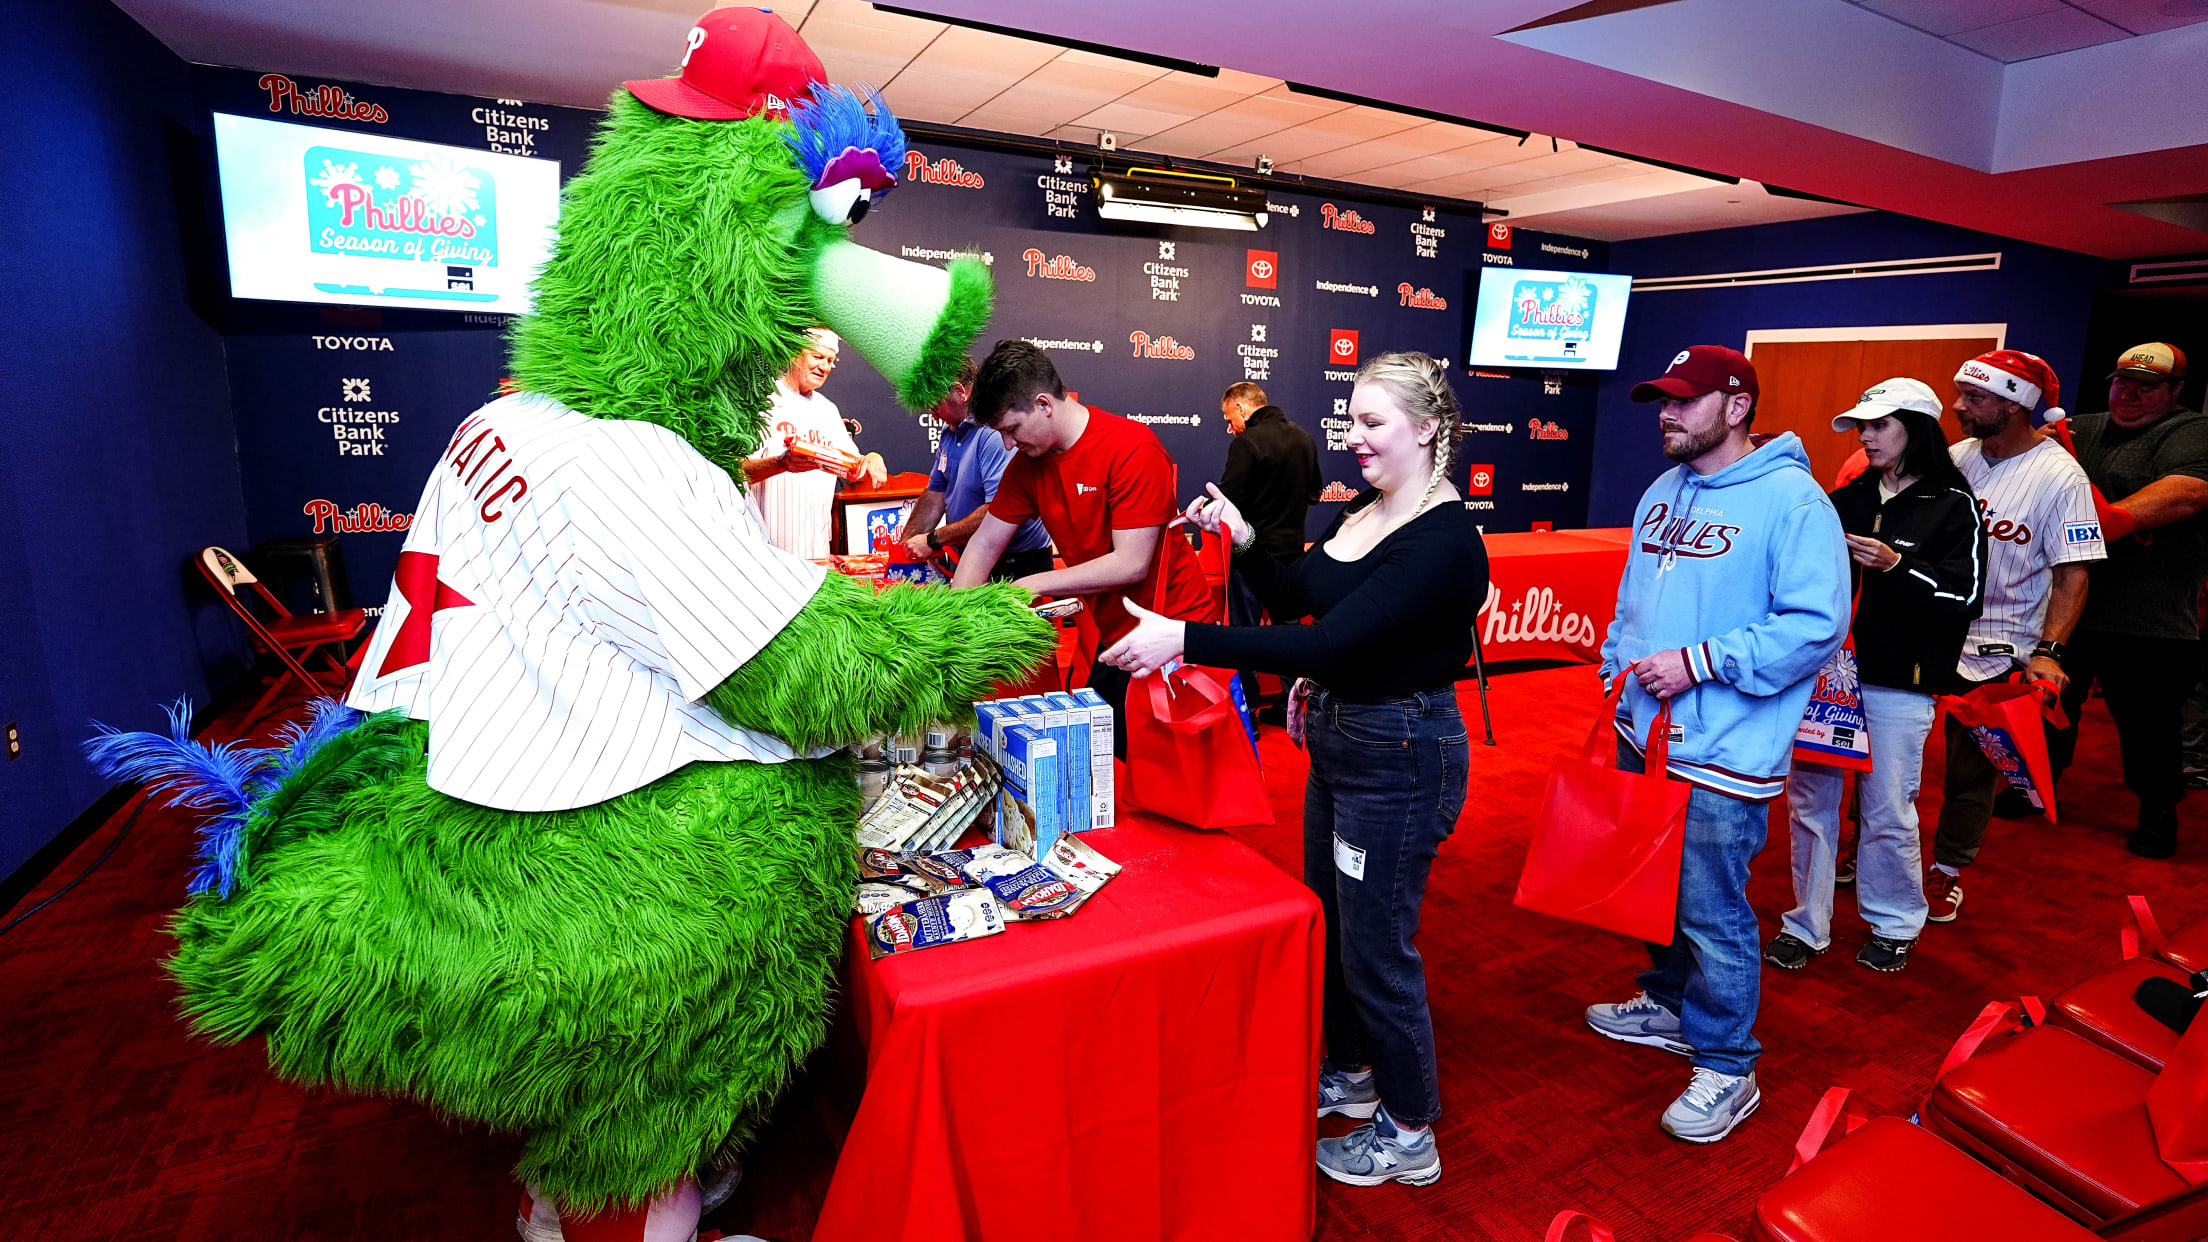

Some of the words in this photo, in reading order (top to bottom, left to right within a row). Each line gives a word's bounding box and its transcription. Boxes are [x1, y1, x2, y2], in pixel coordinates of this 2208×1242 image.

[258, 74, 389, 124] Phillies
[472, 107, 549, 132] Citizens
[486, 126, 534, 147] Bank
[905, 151, 984, 188] Phillies
[1037, 175, 1088, 193] Citizens
[1045, 190, 1077, 206] Bank
[329, 183, 477, 239] Phillies
[1047, 204, 1075, 218] Park
[1320, 203, 1375, 235] Phillies
[1410, 223, 1445, 238] Citizens
[319, 229, 399, 255] Season
[403, 240, 423, 262] of
[430, 238, 494, 266] Giving
[1415, 235, 1437, 248] Bank
[1541, 243, 1582, 256] Independence
[1416, 246, 1436, 258] Park
[1482, 253, 1513, 265] TOYOTA
[1023, 248, 1095, 282] Phillies
[1143, 262, 1189, 278] Citizens
[1150, 276, 1180, 290] Bank
[1316, 280, 1369, 295] Independence
[1152, 288, 1178, 301] Park
[1240, 293, 1281, 308] TOYOTA
[1398, 282, 1447, 310] Phillies
[1520, 299, 1583, 326] Phillies
[1511, 324, 1546, 336] Season
[1547, 326, 1558, 340] of
[1559, 327, 1590, 341] Giving
[312, 336, 394, 352] TOYOTA
[1130, 331, 1195, 360] Phillies
[1237, 344, 1279, 358] Citizens
[1243, 357, 1269, 369] Bank
[2130, 353, 2155, 364] AHEAD
[1244, 369, 1267, 380] Park
[1324, 371, 1356, 382] TOYOT
[1544, 385, 1560, 395] Park
[317, 407, 400, 424] Citizens
[333, 424, 385, 440] Bank
[1529, 418, 1568, 440] Phillies
[339, 440, 384, 456] Park
[1327, 441, 1348, 451] Park
[1522, 483, 1561, 492] Independence
[1464, 502, 1494, 510] TOYOTA
[2066, 526, 2101, 543] IBX
[1805, 704, 1820, 722] of
[1823, 705, 1866, 733] Giving
[1021, 881, 1068, 907] IDAHOAN
[885, 913, 910, 944] IDAHOAN
